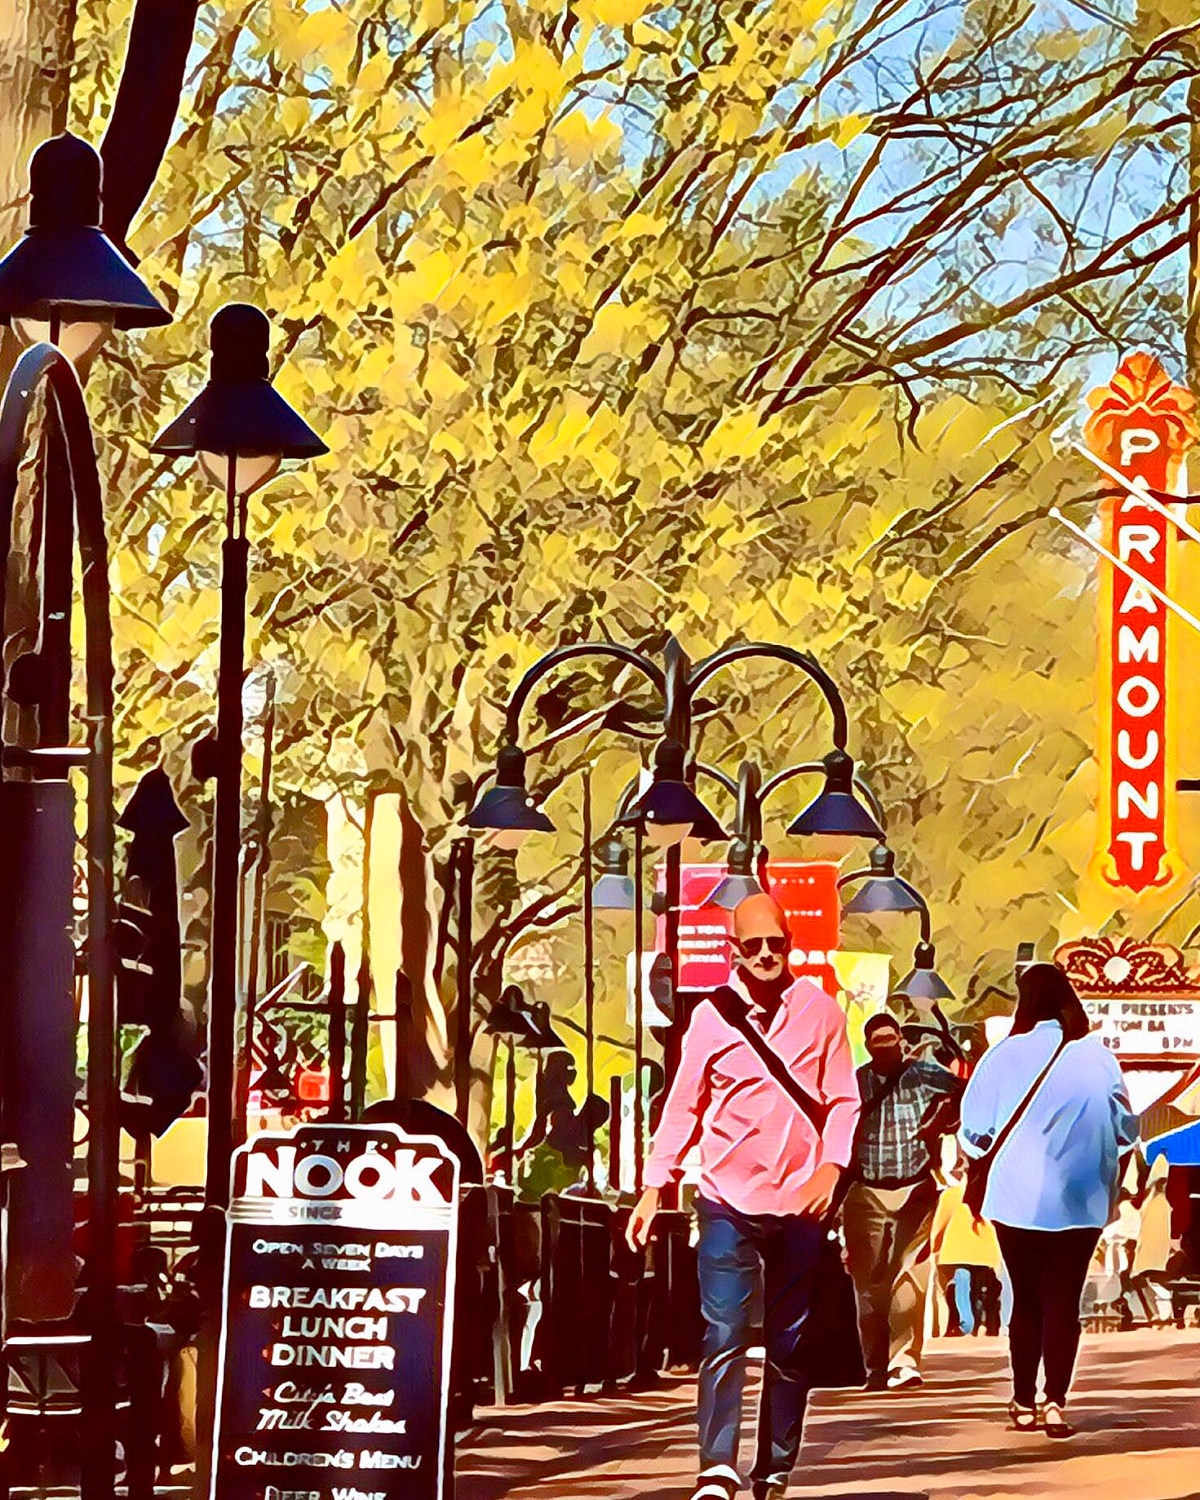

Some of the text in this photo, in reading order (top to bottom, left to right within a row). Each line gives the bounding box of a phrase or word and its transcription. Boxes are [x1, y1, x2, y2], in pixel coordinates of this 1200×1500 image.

[1116, 428, 1161, 871] PARAMOUNT
[1121, 1003, 1194, 1016] PRESENTS
[313, 1140, 378, 1153] THE
[244, 1146, 451, 1202] NOOK
[288, 1206, 343, 1219] SINCE
[302, 1258, 316, 1270] A
[249, 1285, 427, 1314] BREAKFAST
[281, 1316, 388, 1341] LUNCH
[271, 1343, 395, 1370] DINNER
